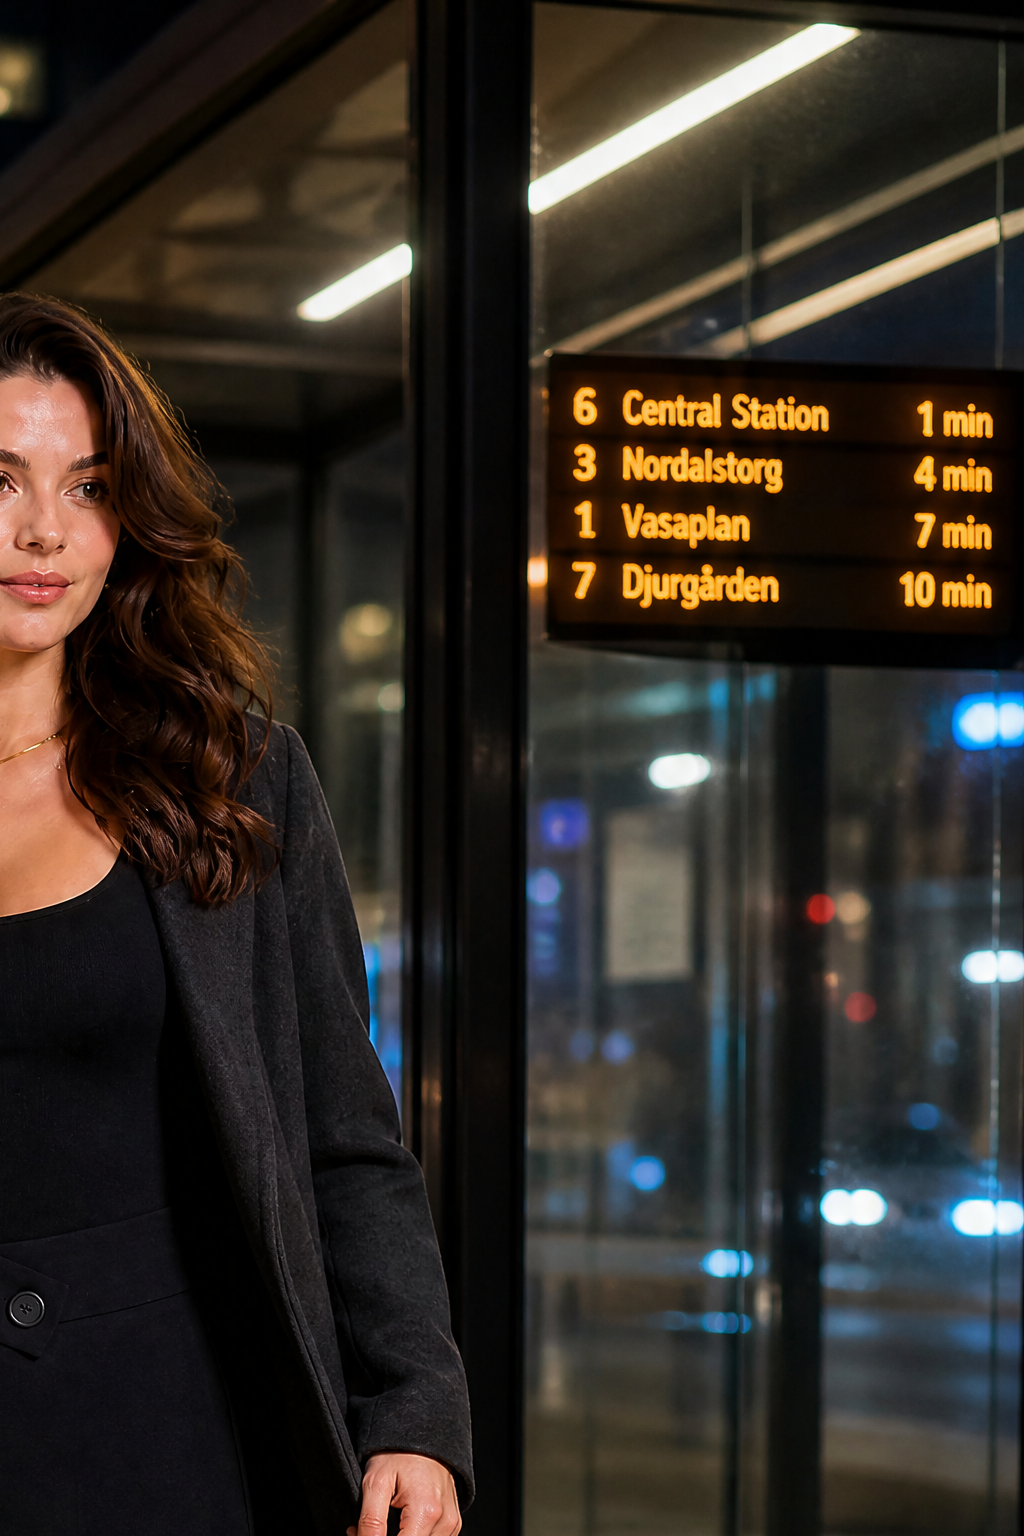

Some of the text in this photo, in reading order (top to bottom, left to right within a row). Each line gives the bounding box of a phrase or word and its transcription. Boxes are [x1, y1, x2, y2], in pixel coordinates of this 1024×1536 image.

[573, 387, 993, 438] 6 Central Station 1 min
[573, 444, 992, 493] 3 Nordalstorg 4 min
[574, 501, 992, 550] 1 Vasaplan 7 min
[572, 562, 992, 609] 7 Djurgården 10 min
